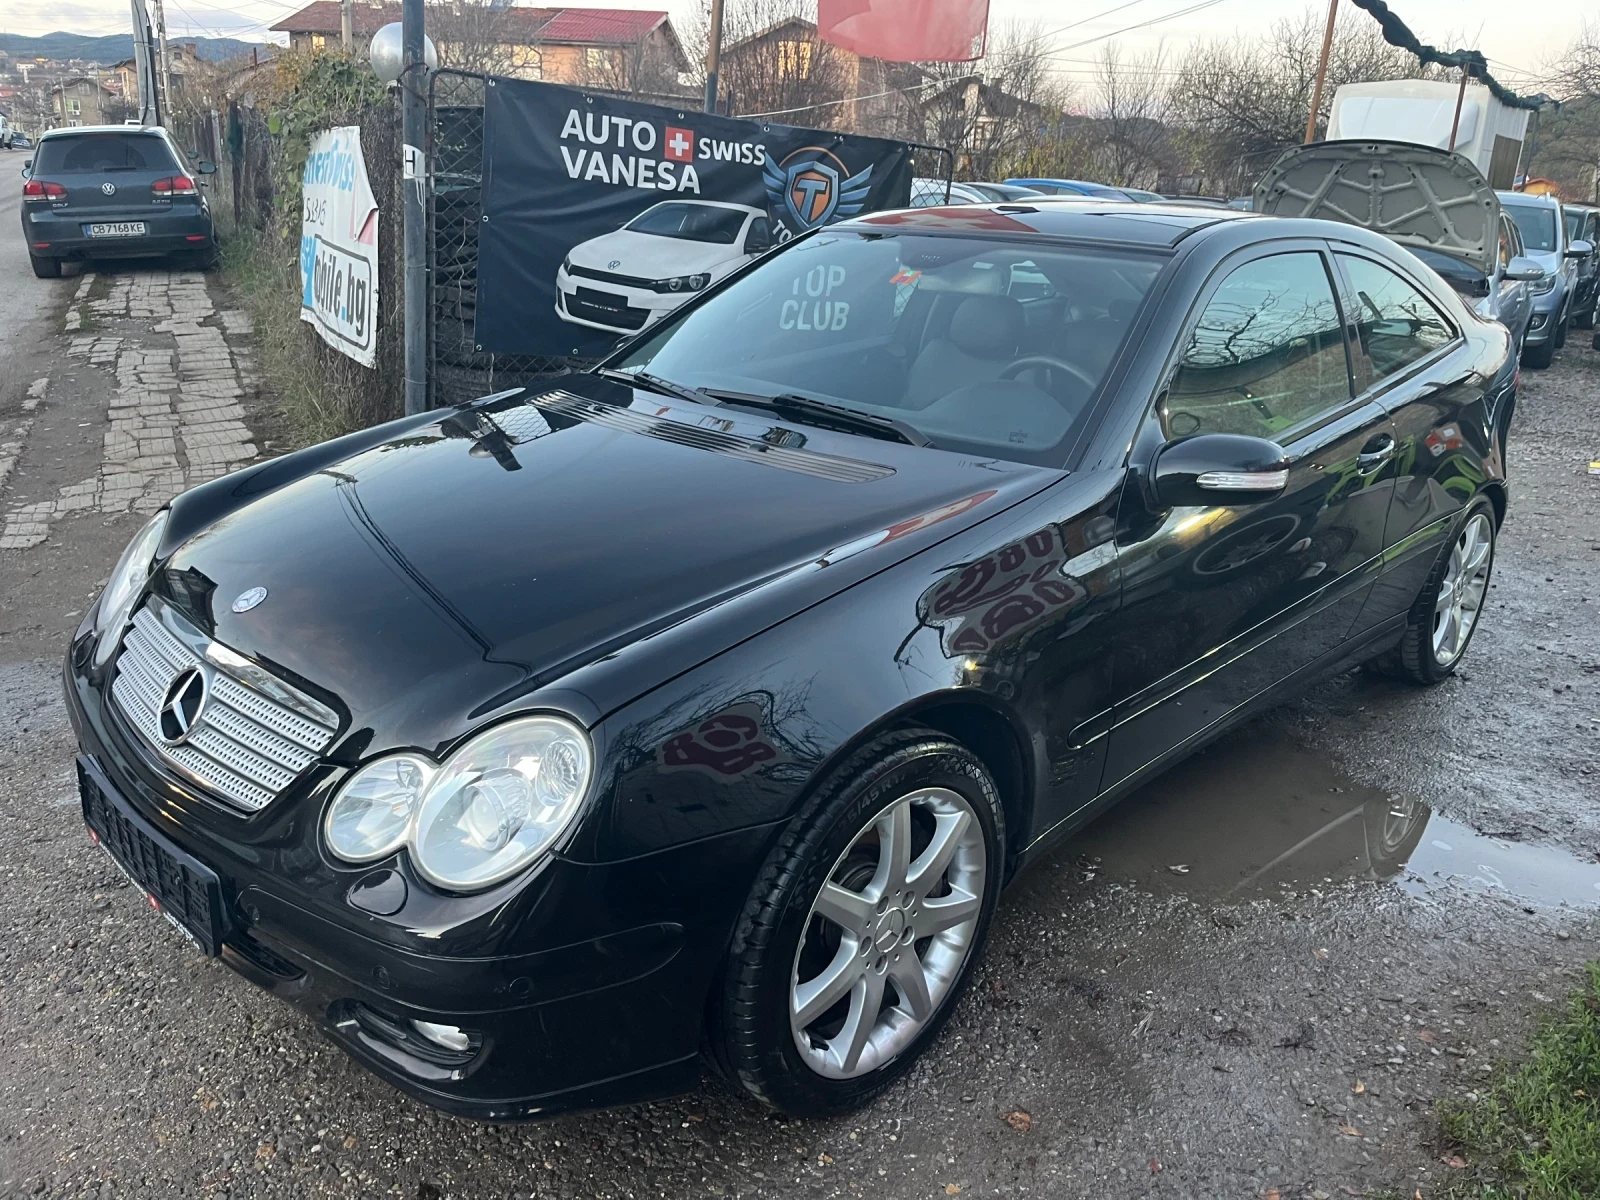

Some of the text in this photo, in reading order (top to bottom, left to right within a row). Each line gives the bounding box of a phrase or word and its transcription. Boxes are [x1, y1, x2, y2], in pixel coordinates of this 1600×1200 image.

[560, 109, 766, 166] AUTO SWISS
[560, 145, 701, 195] VANESA
[772, 218, 796, 244] TO
[779, 299, 850, 331] CLUB
